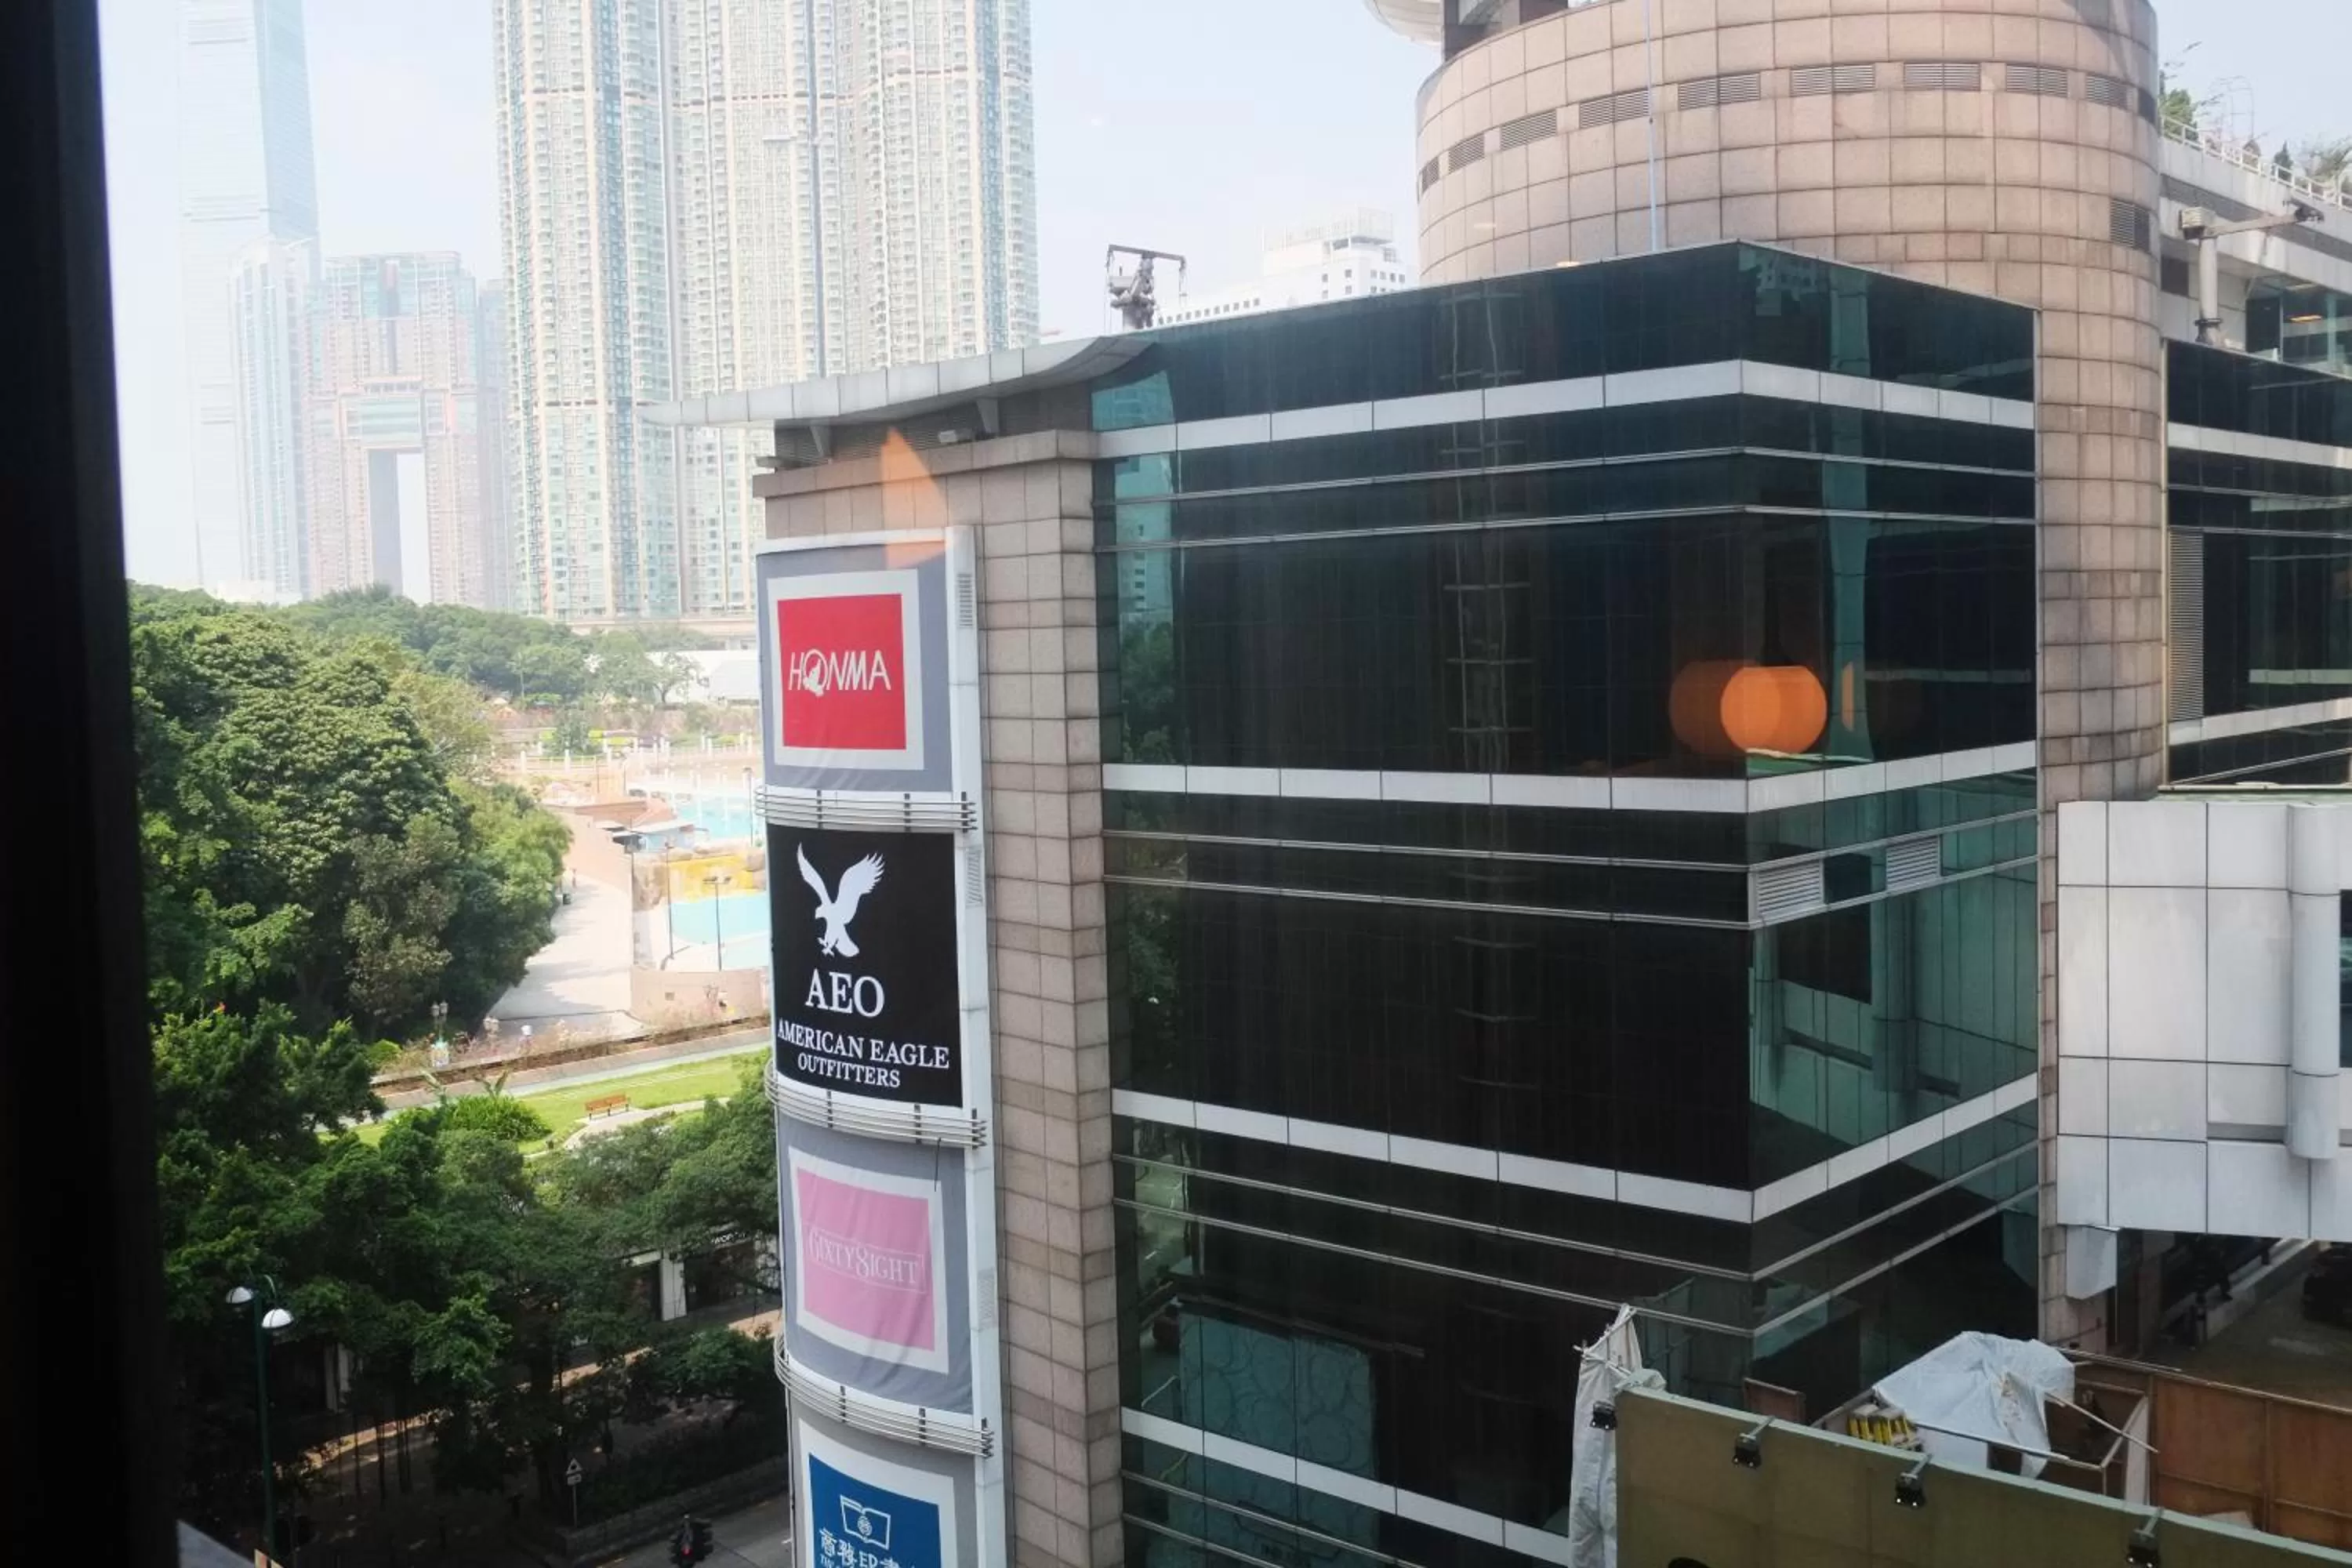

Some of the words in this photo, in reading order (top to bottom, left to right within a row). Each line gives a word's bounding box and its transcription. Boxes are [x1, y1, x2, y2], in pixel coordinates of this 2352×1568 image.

[789, 649, 891, 694] HONMA
[805, 968, 885, 1018] AEO
[777, 1018, 865, 1059] AMERICAN
[869, 1038, 950, 1069] EAGLE
[797, 1053, 901, 1088] OUTFITTERS
